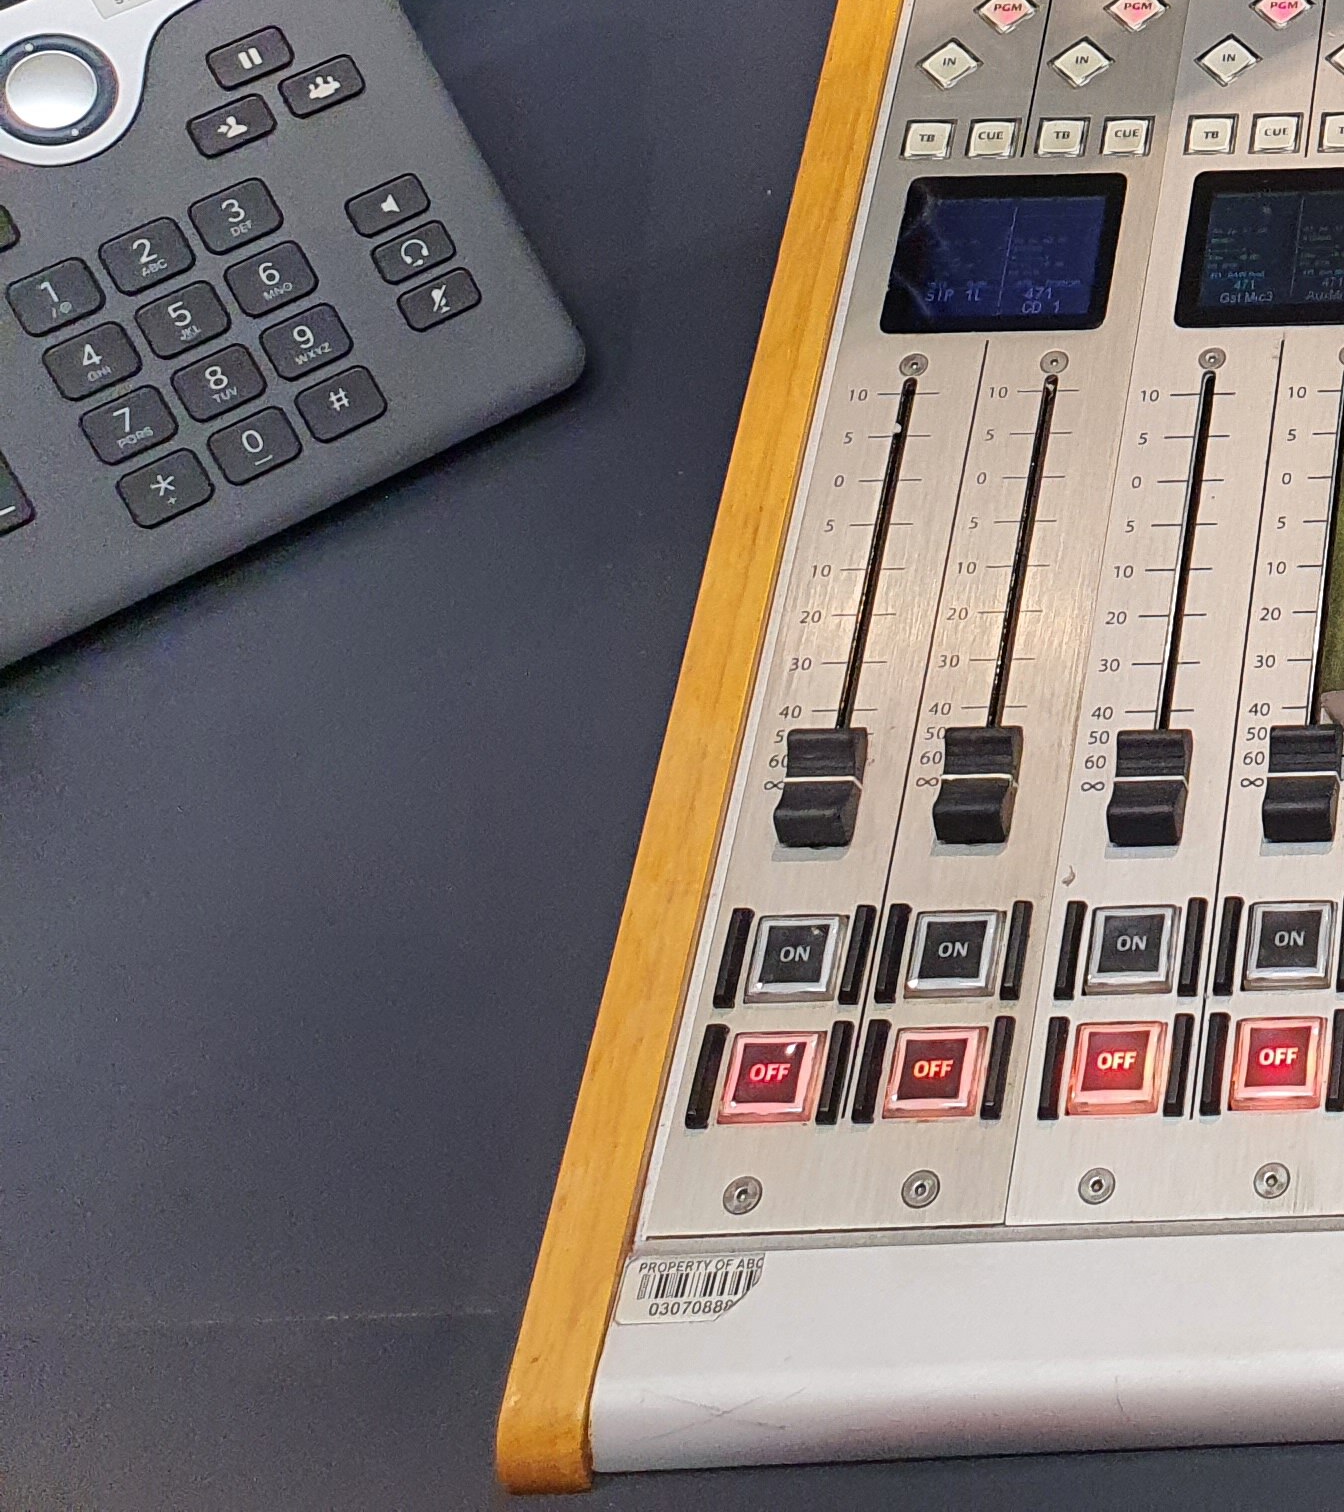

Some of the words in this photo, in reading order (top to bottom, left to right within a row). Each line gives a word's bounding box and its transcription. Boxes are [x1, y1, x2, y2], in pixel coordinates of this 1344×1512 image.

[993, 3, 1023, 14] PGM
[943, 57, 957, 67] IN
[919, 133, 936, 143] TB
[977, 130, 1004, 141] CUE
[221, 199, 246, 224] 3
[132, 238, 157, 265] 2
[293, 324, 315, 349] 9
[205, 366, 229, 389] 8
[1140, 389, 1160, 402] 10
[1106, 611, 1128, 625] 20
[1099, 658, 1121, 672] 30
[1091, 706, 1114, 720] 40
[778, 944, 811, 964] ON
[748, 1062, 790, 1084] OFF
[639, 1260, 713, 1273] PROPERTY
[715, 1259, 732, 1270] OF
